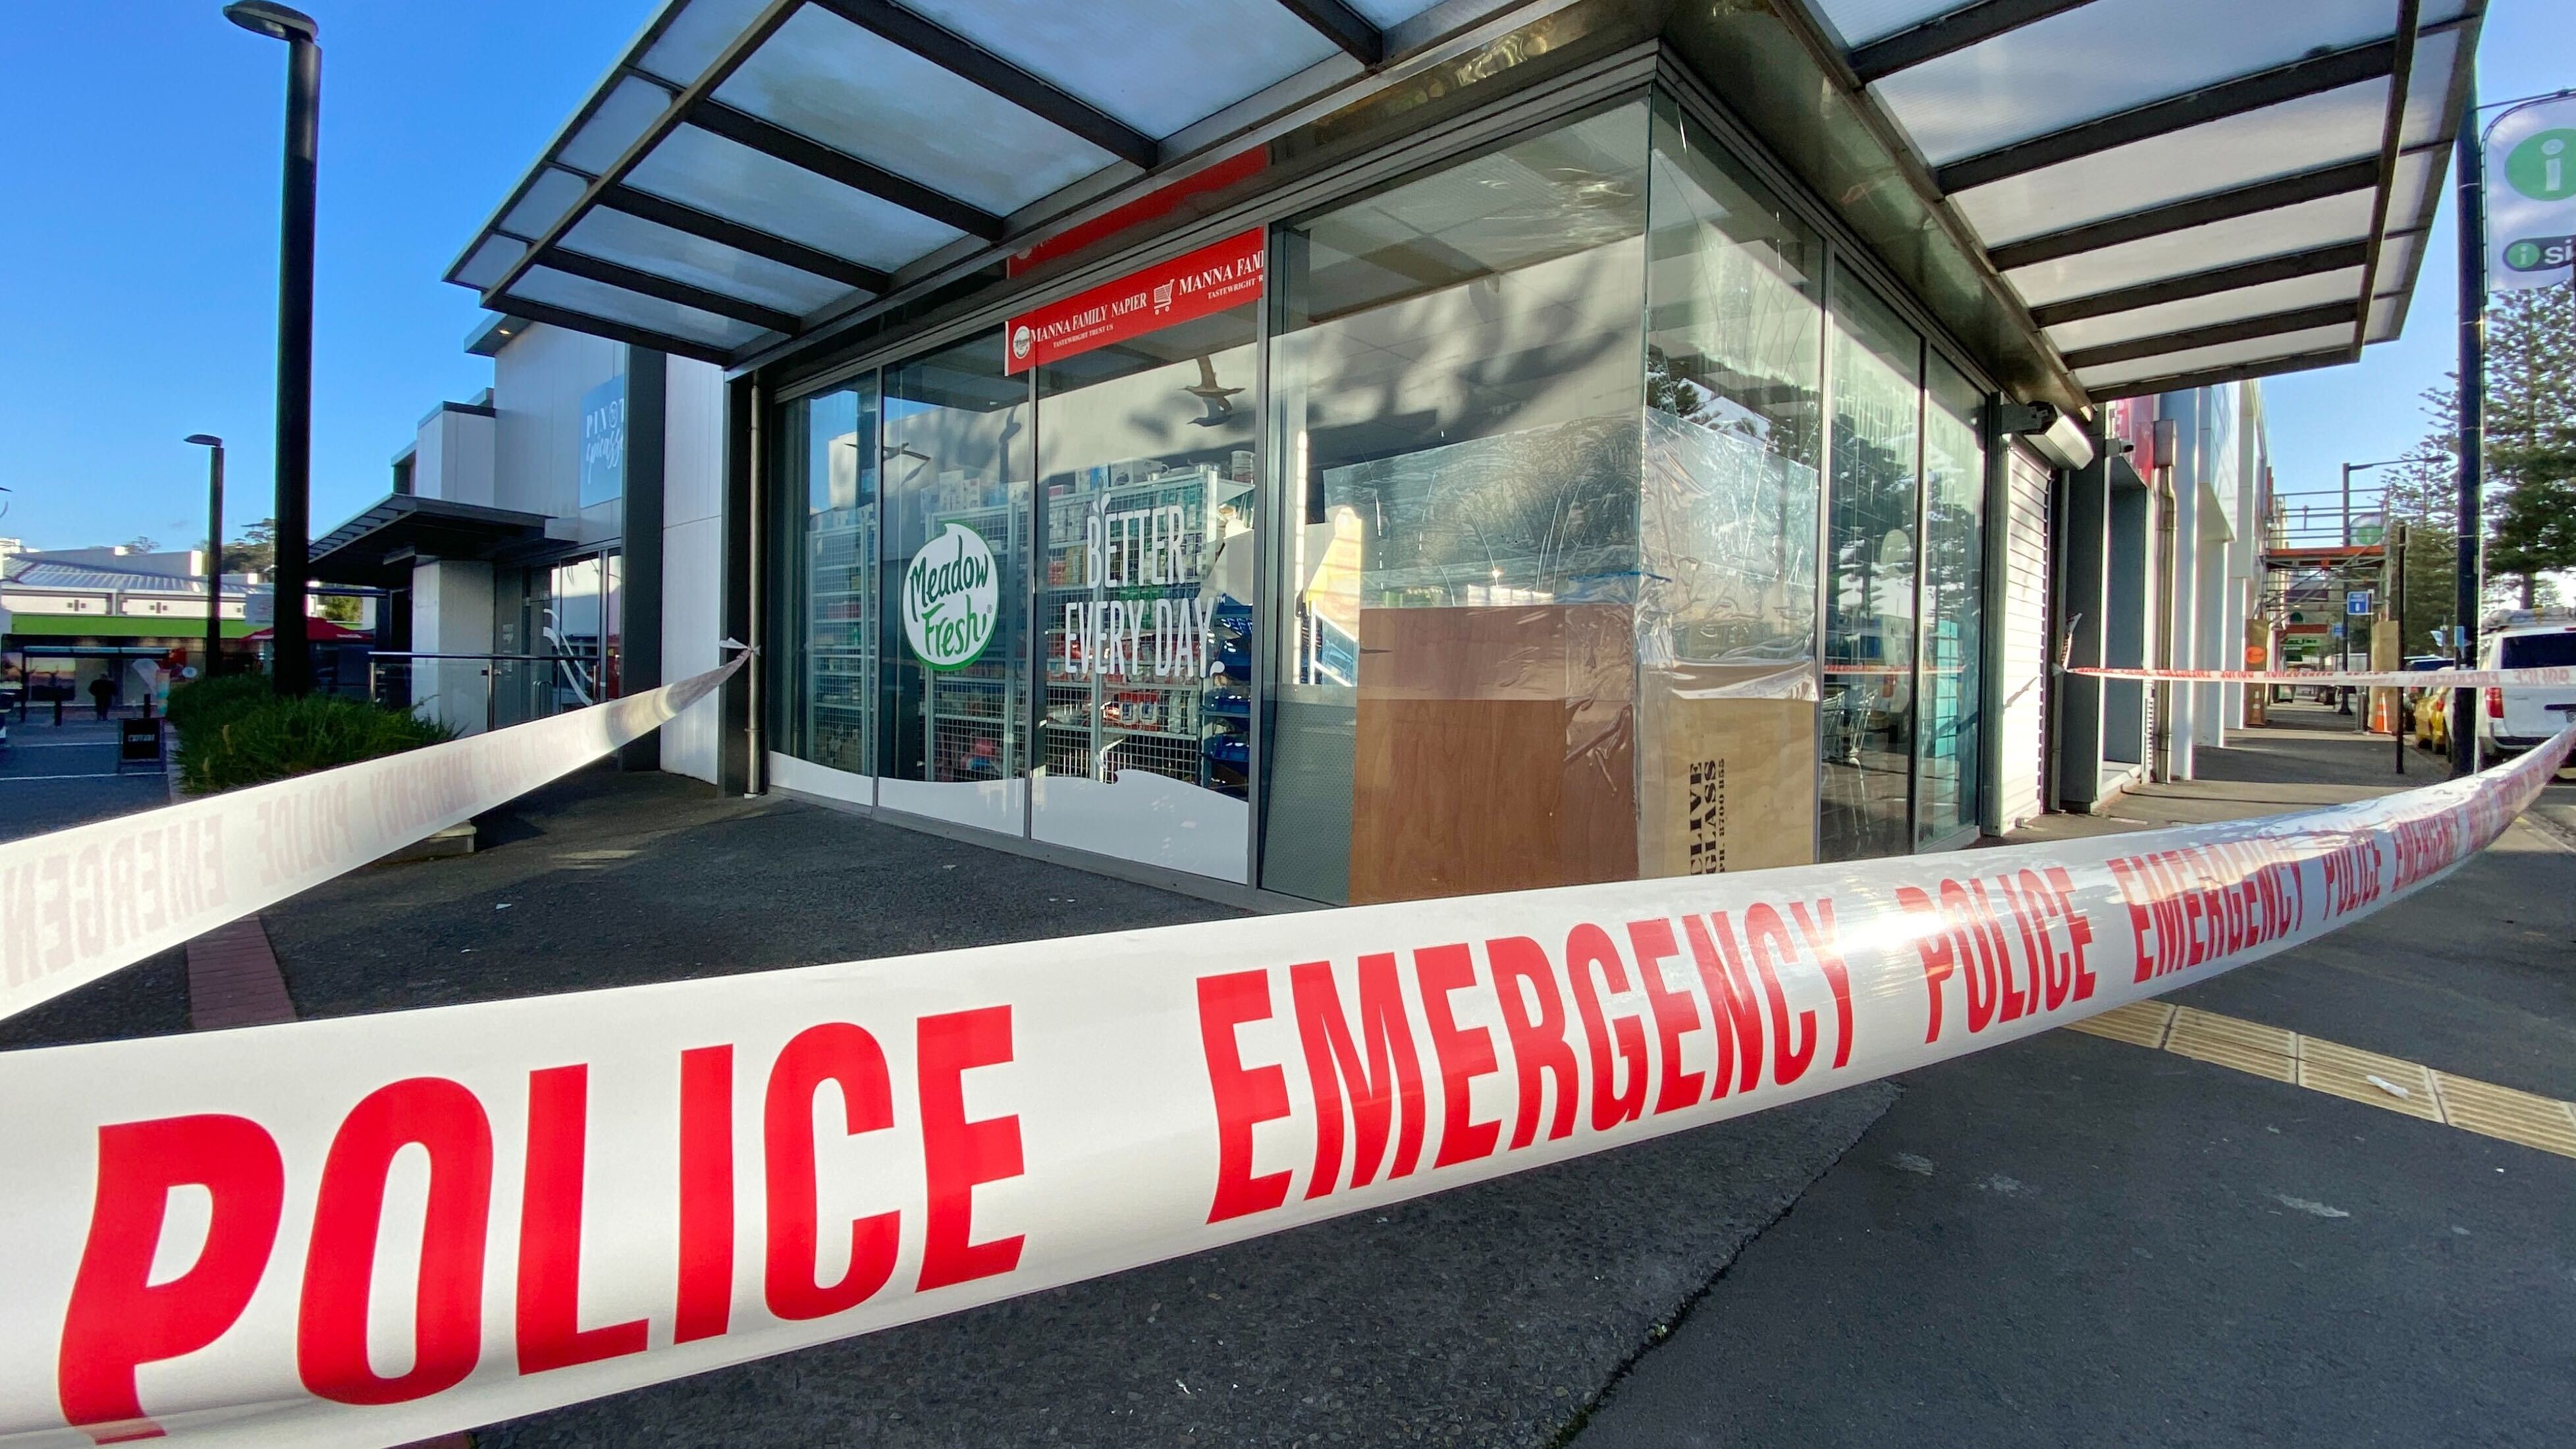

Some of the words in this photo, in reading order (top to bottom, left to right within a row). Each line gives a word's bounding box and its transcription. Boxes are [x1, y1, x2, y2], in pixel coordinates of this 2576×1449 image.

[1031, 319, 1071, 344] MANNA
[1072, 304, 1108, 331] FAMILY
[1111, 292, 1147, 317] NAPIER
[1179, 264, 1233, 296] MANNA
[1208, 278, 1256, 300] TASTEWRIGHT
[1053, 332, 1088, 348] TASTEWRIGHT
[1089, 327, 1107, 337] TRUST
[909, 534, 989, 622] Meadow
[1087, 505, 1185, 589] BETTER
[1065, 599, 1144, 676] EVERY
[1690, 762, 1703, 875] CLIVE
[1704, 760, 1717, 874] GLASS
[57, 1004, 1027, 1446] POLICE
[1196, 897, 1854, 1224] EMERGENCY
[1895, 866, 2097, 1044] POLICE
[2106, 839, 2303, 984] EMERGENCY
